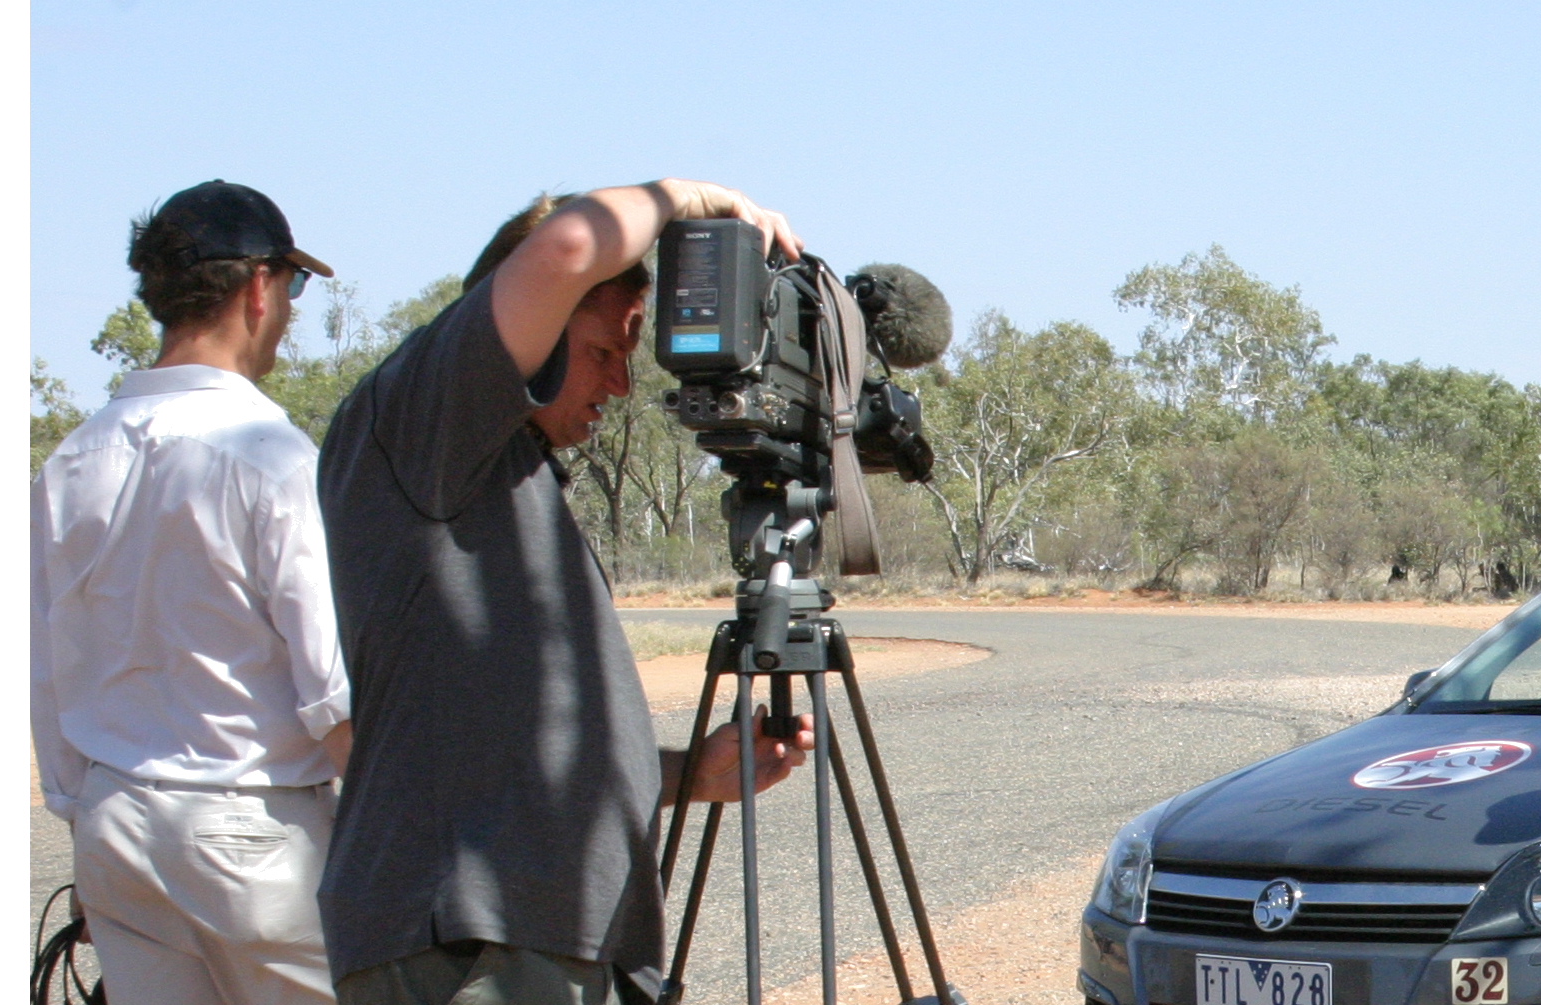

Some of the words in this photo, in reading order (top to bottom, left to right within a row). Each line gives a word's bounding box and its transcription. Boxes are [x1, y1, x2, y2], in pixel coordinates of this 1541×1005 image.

[1255, 797, 1448, 821] DIESEL
[1201, 965, 1247, 1005] TTL
[1455, 960, 1504, 1003] 32
